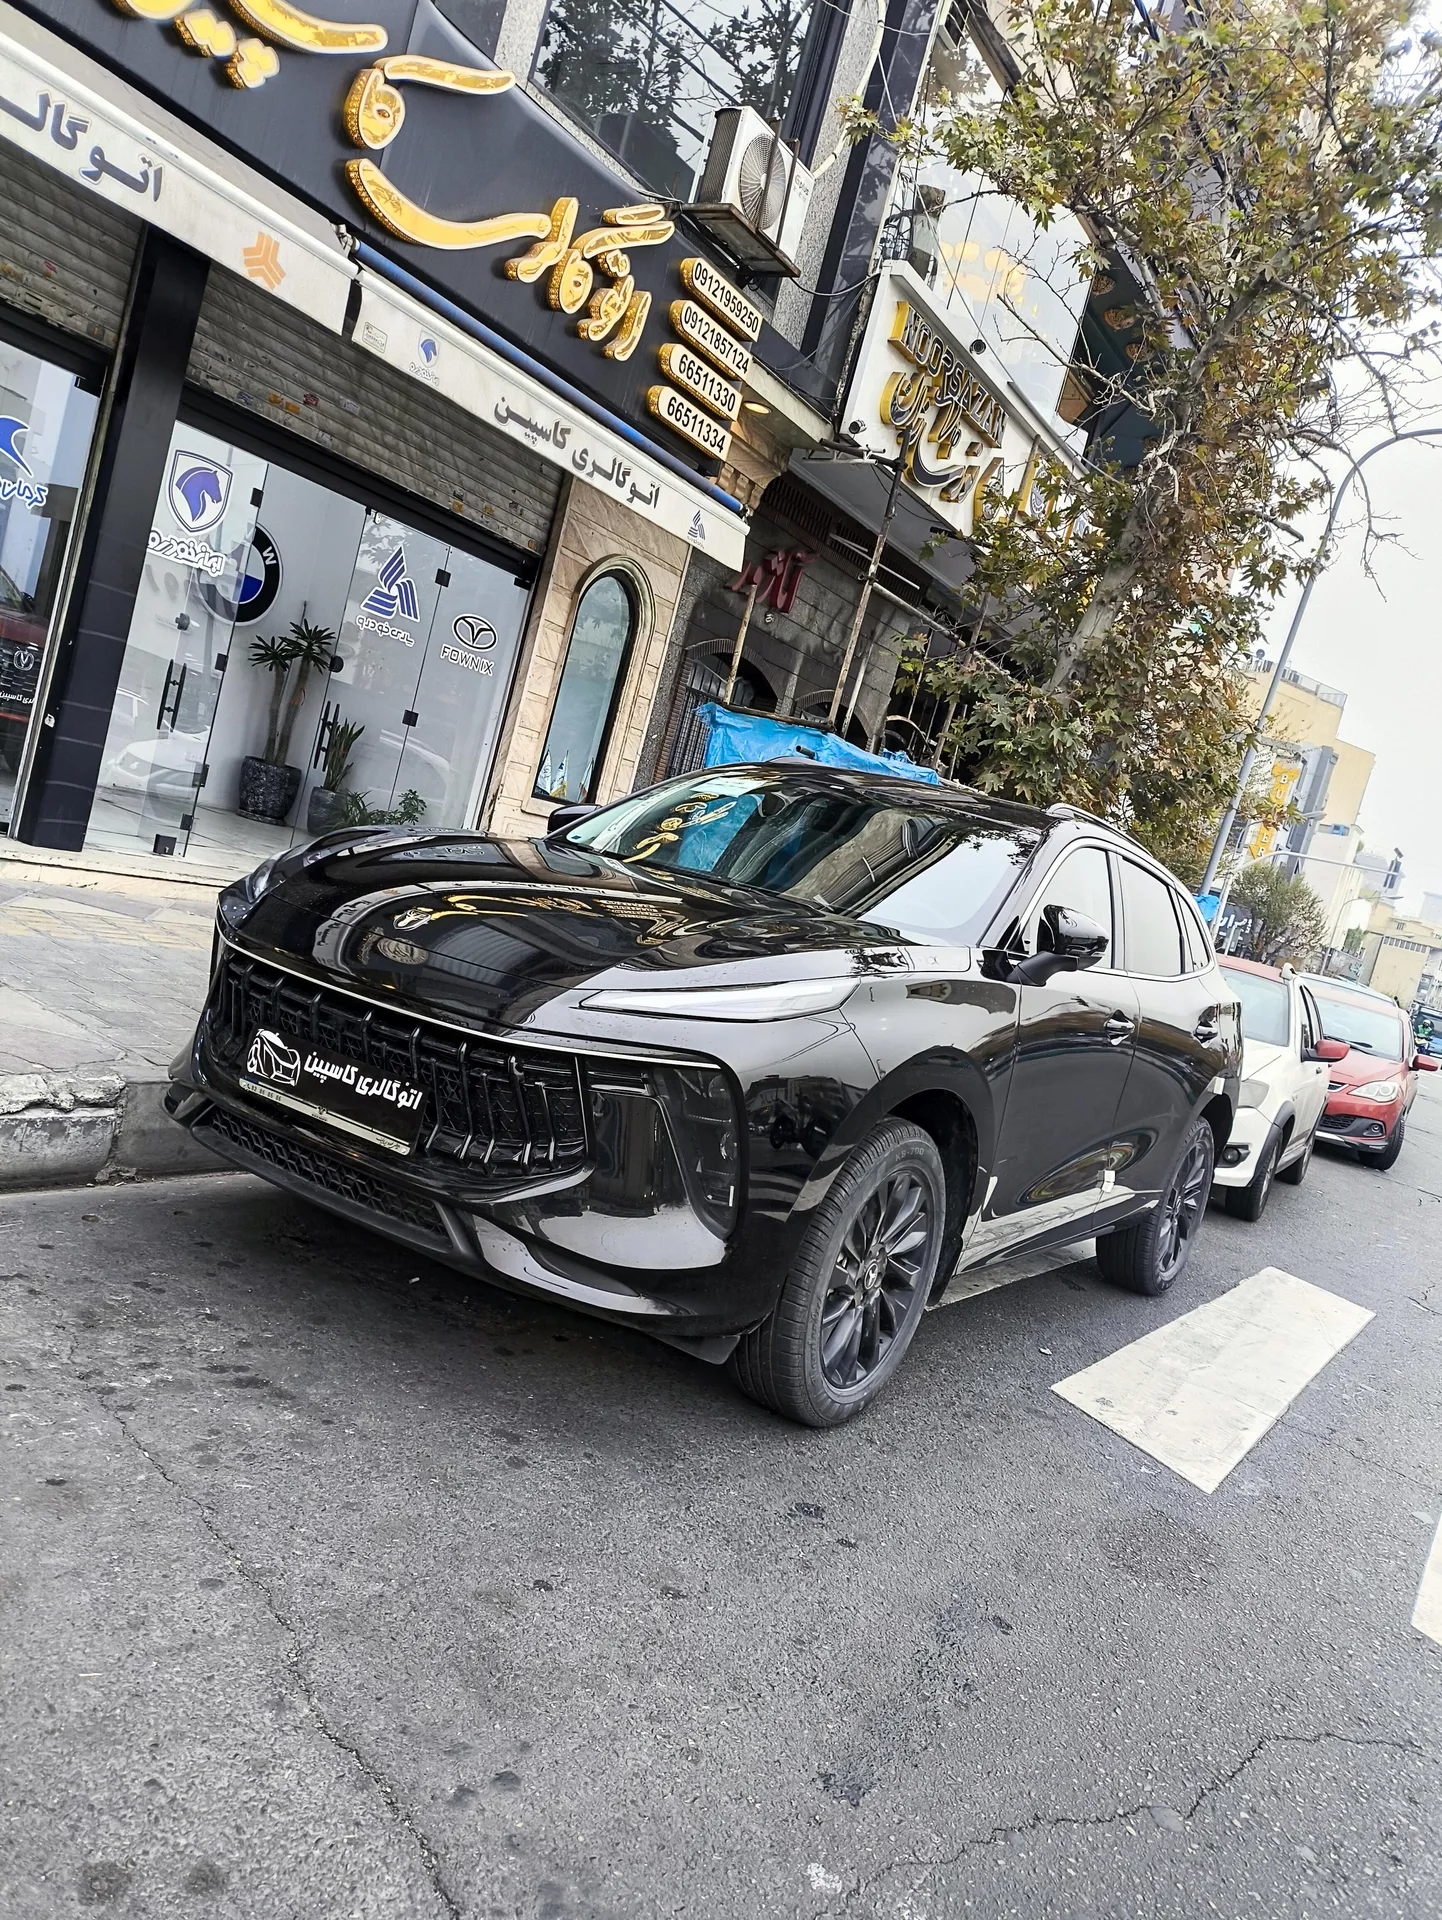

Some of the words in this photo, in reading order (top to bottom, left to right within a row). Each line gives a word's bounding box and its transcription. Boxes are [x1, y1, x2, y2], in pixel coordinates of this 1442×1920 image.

[694, 262, 759, 334] 09121959250
[684, 306, 750, 375] 09121857124
[678, 353, 736, 413] 66511330
[888, 301, 1009, 449] NOORSAZAN
[493, 396, 572, 447] کاسپین
[667, 396, 725, 454] 66511334
[440, 643, 495, 676] FOWNIX
[1257, 772, 1290, 858] BUER
[303, 1052, 358, 1083] کاسپین
